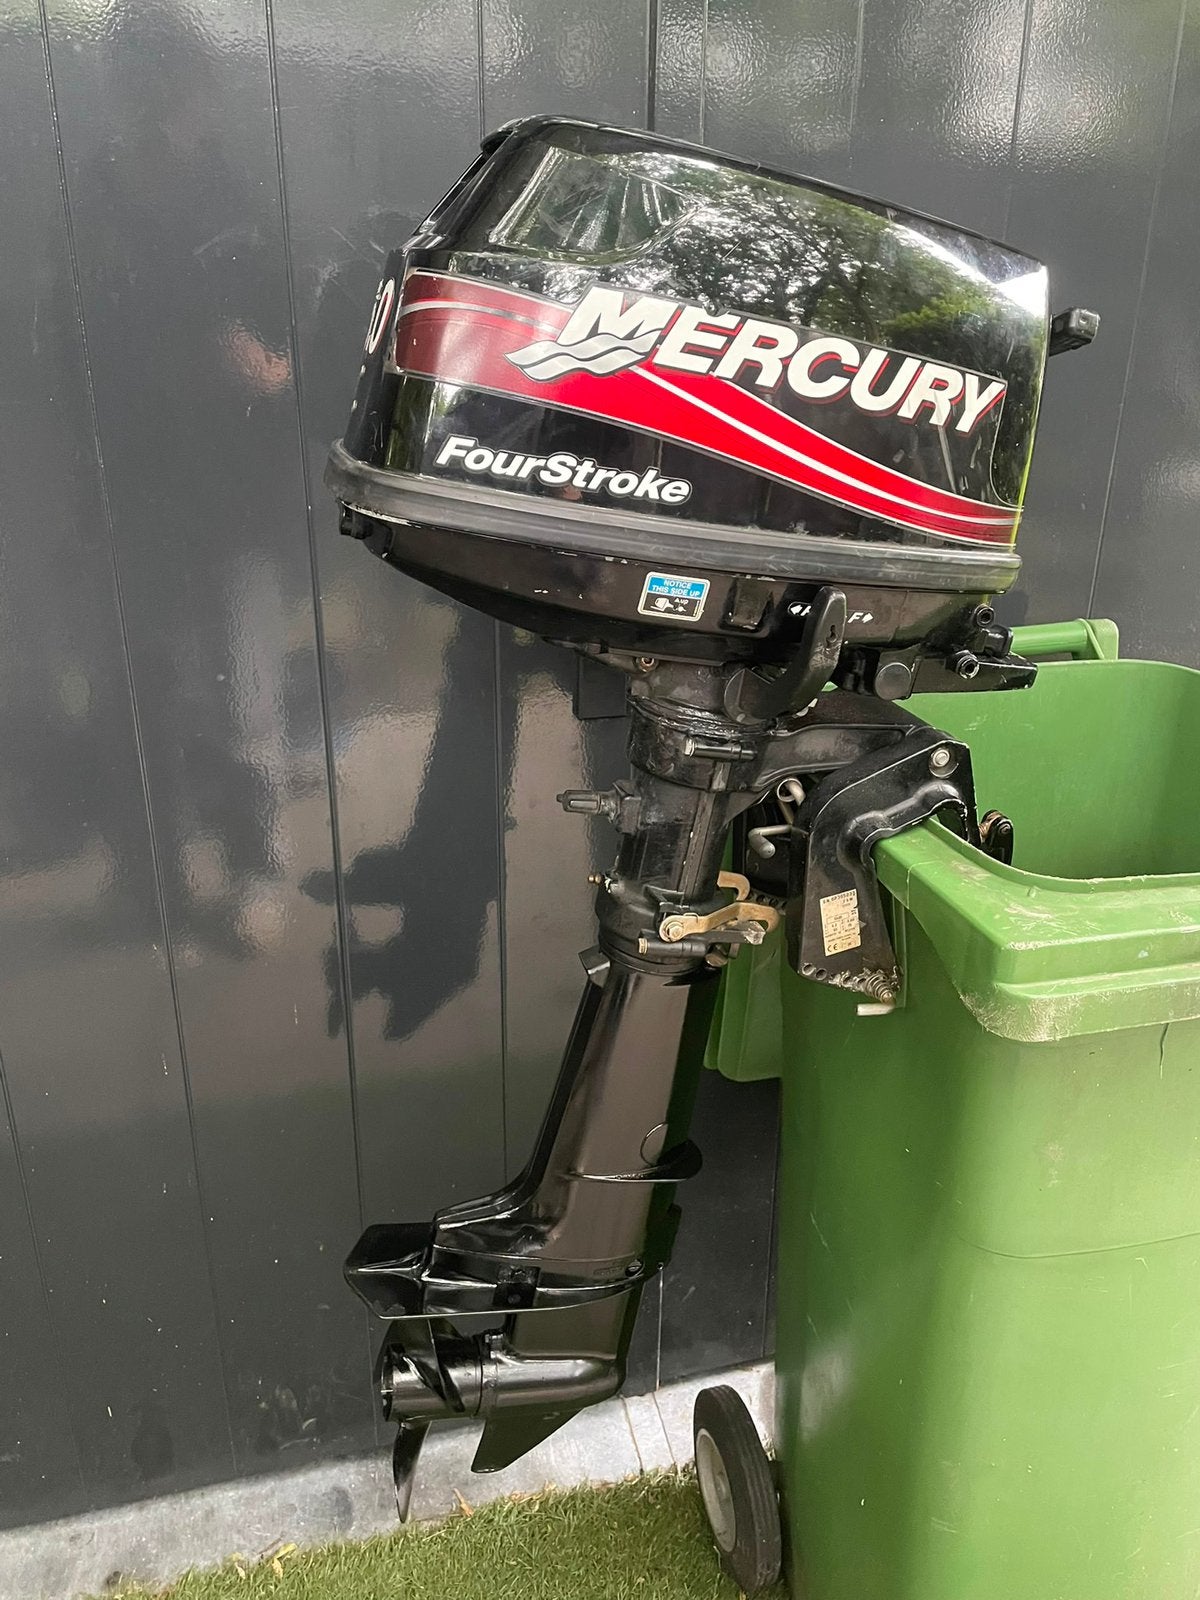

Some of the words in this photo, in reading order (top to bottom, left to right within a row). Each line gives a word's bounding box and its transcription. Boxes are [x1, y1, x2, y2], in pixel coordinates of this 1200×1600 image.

[554, 285, 1007, 434] MERCURY
[435, 434, 692, 504] FourStroke
[663, 579, 692, 589] NOTICE
[651, 585, 669, 594] THIS
[670, 587, 688, 596] SIDE
[847, 612, 864, 623] F
